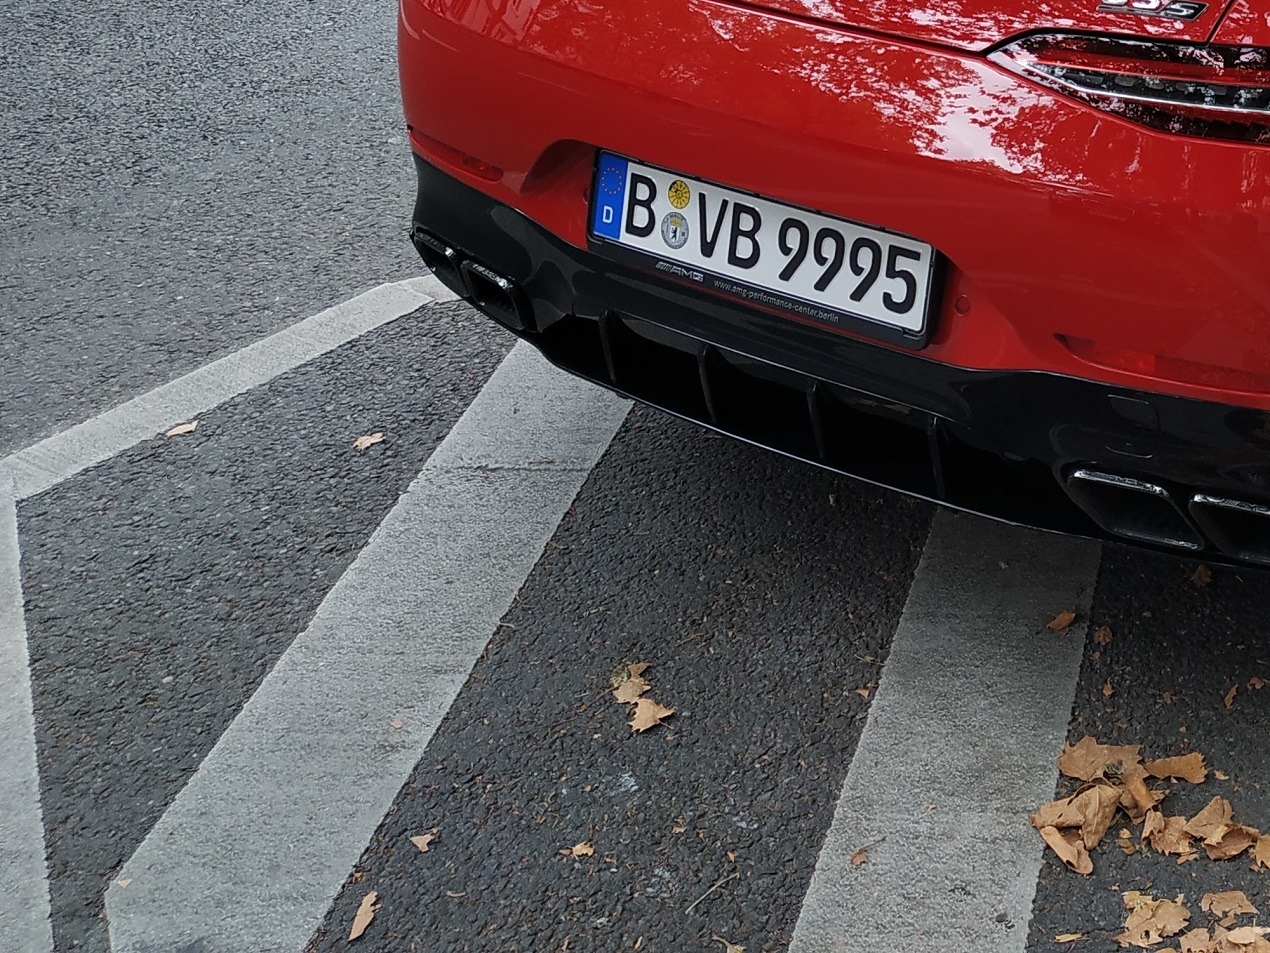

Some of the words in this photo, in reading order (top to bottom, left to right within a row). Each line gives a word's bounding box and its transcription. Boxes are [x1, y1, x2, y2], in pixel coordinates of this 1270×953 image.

[602, 205, 613, 224] D
[625, 172, 657, 238] B
[698, 191, 762, 270] VB
[778, 217, 922, 315] 9995
[668, 263, 704, 283] AMG
[713, 279, 840, 324] www.amg-performance-center.berlin
